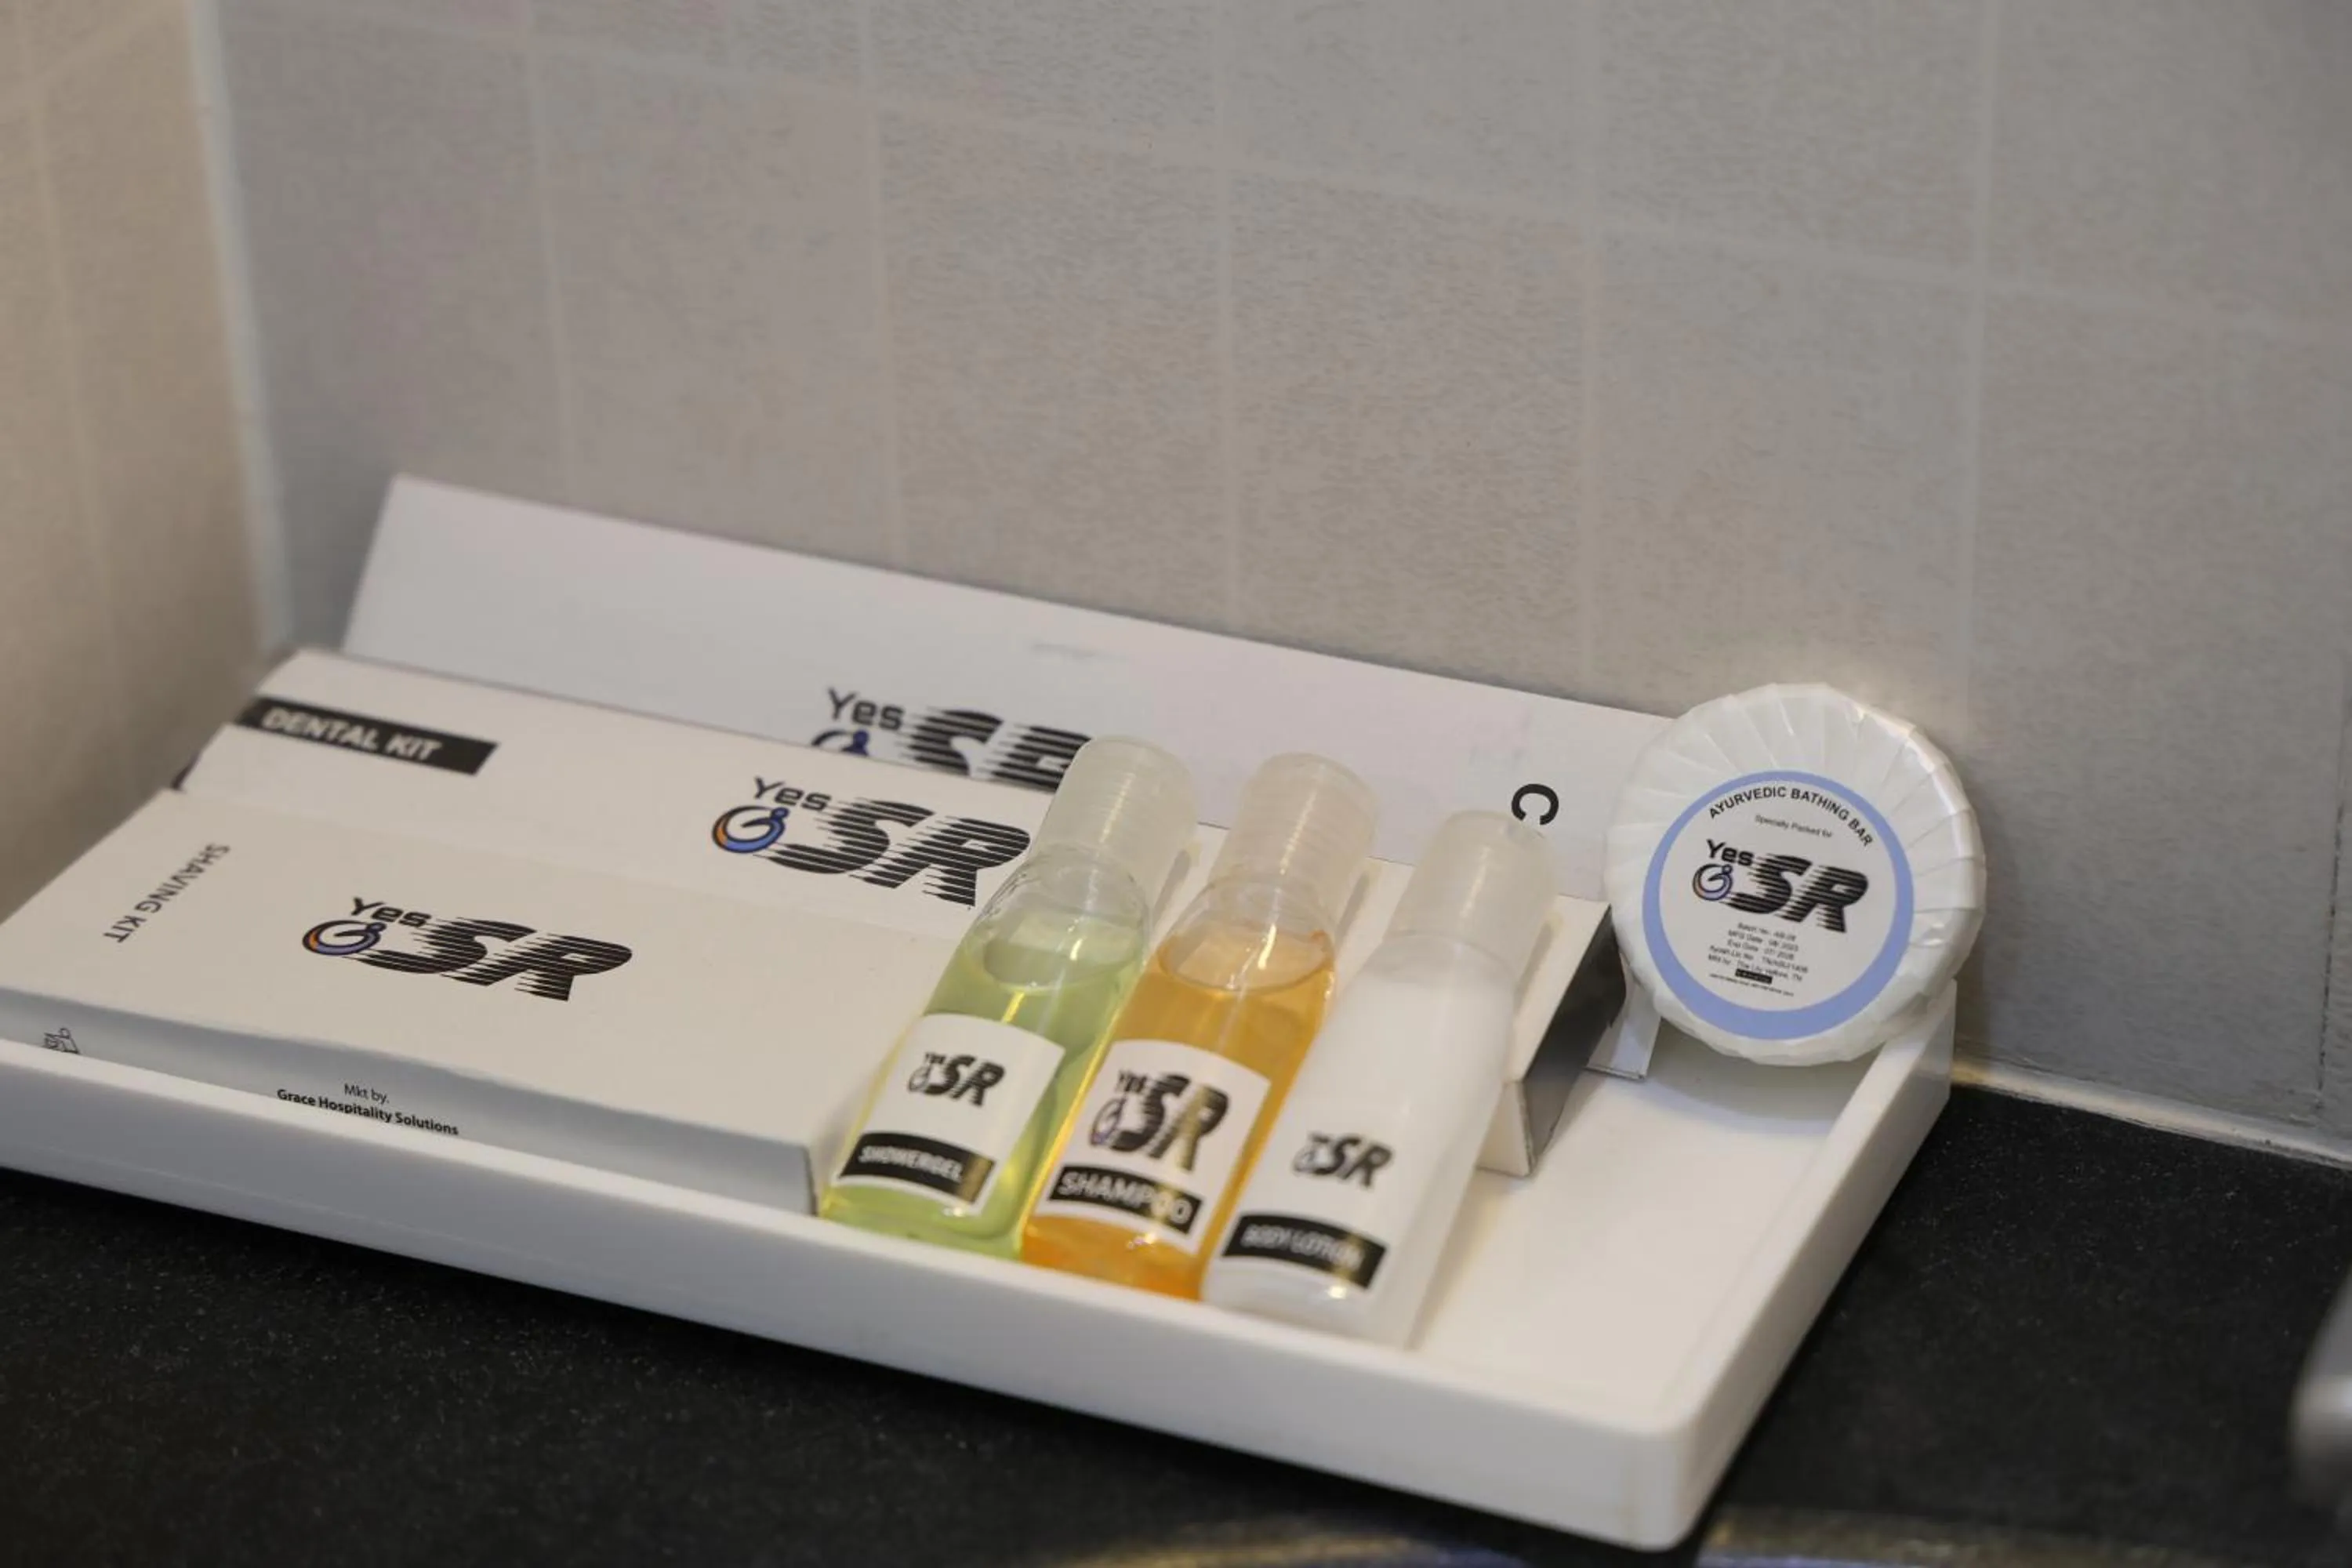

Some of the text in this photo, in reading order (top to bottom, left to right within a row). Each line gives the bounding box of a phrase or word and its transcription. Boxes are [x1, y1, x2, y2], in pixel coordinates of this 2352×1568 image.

[262, 706, 443, 760] DENTAL KIT
[828, 688, 906, 731] Yes
[753, 777, 1030, 907] Yes SR
[1709, 786, 1874, 847] AYURVEDIC BATHING BAR
[103, 843, 230, 943] SHAVING KIT
[1706, 838, 1869, 933] Yes SR
[342, 897, 633, 1002] Yes SR
[343, 1083, 368, 1100] Mkt
[923, 1054, 1006, 1108] SR
[277, 1088, 459, 1135] Grace Hospitality Solutions
[1110, 1073, 1229, 1172] SR
[1058, 1171, 1195, 1225] SHAMPOO
